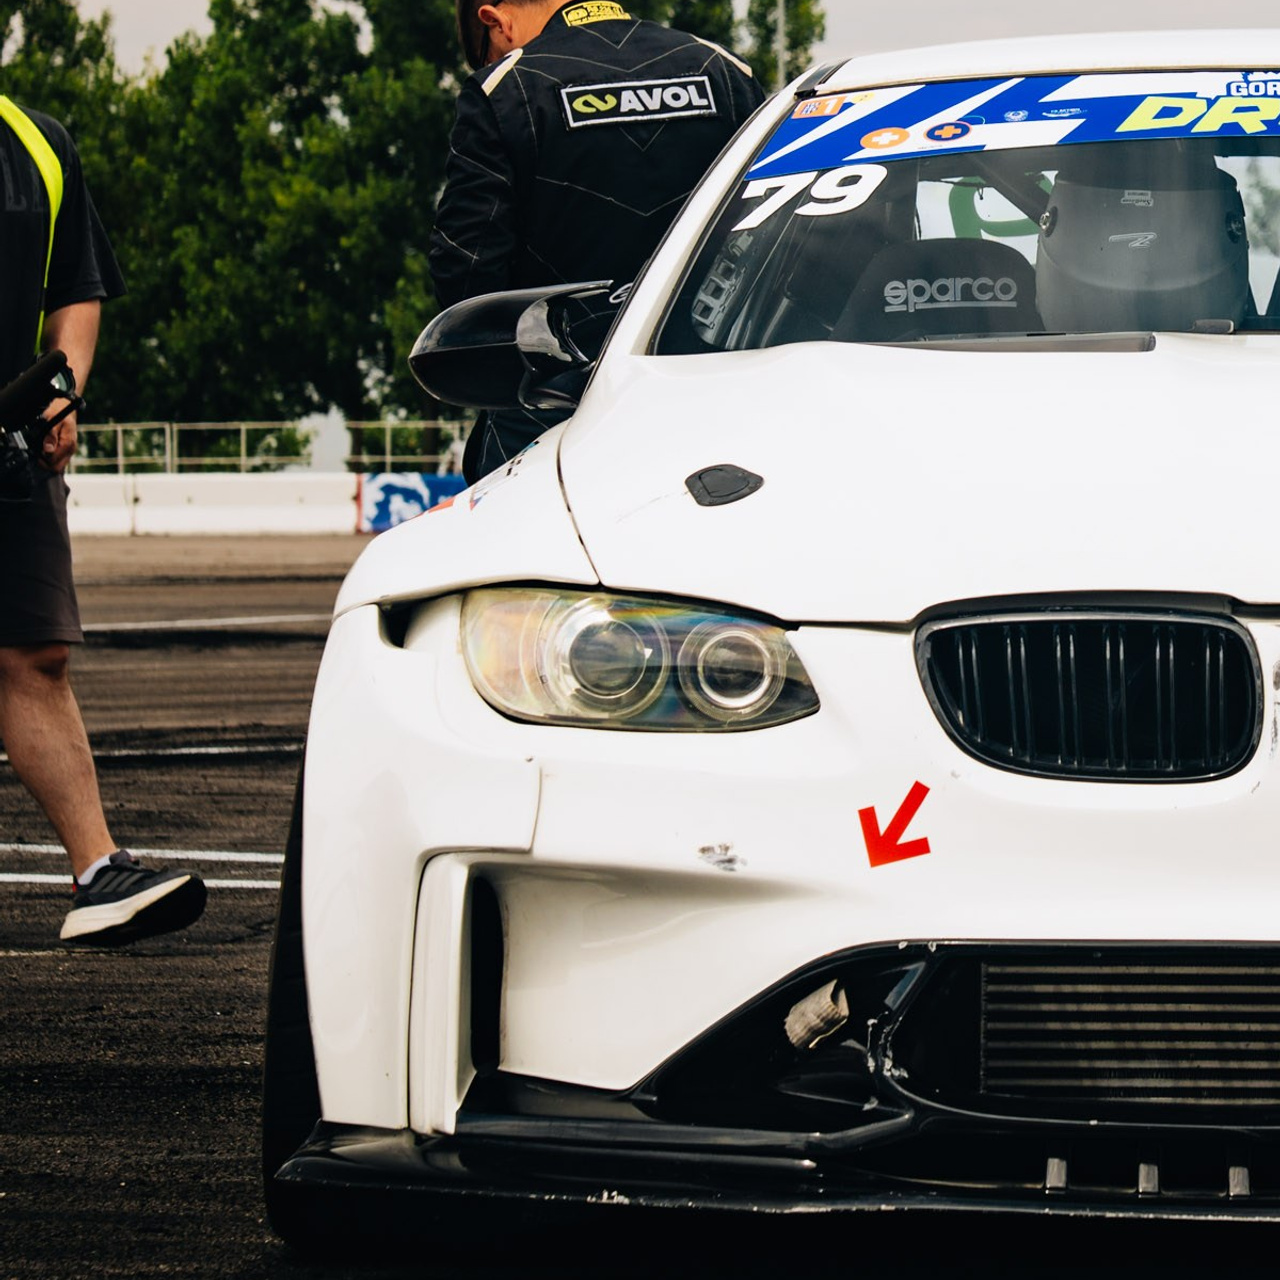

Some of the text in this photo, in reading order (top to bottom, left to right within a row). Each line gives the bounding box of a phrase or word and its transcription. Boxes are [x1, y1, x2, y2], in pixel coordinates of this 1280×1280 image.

[619, 84, 709, 114] AVOL
[731, 164, 888, 232] 79
[883, 275, 1018, 312] sparco
